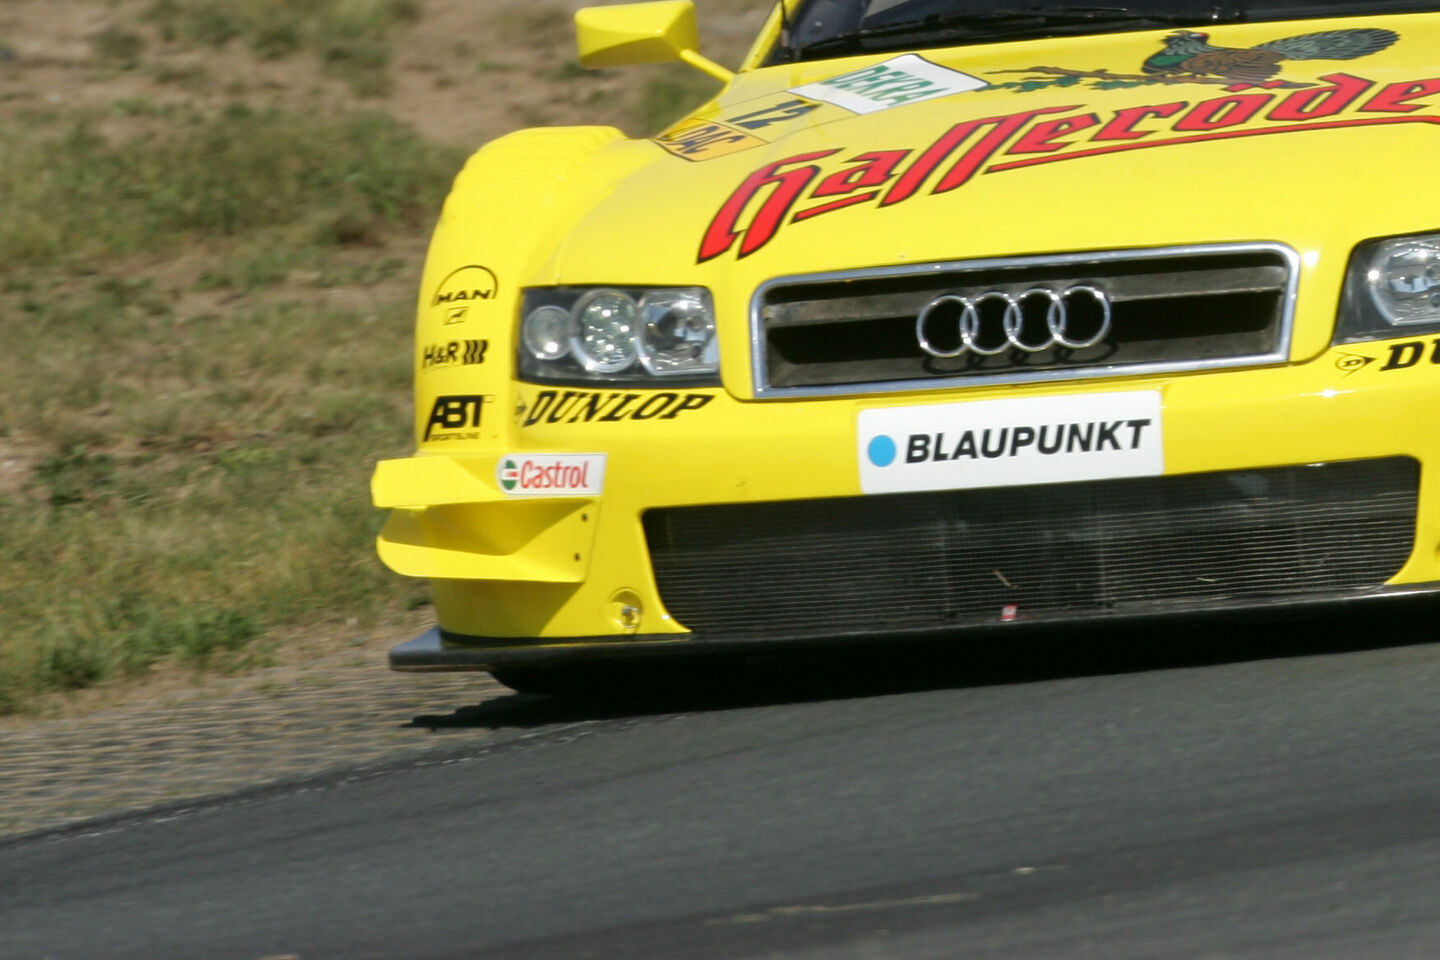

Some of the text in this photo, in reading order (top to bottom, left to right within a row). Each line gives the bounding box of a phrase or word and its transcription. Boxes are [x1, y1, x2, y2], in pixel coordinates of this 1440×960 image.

[817, 65, 949, 107] DEKRA
[437, 289, 491, 305] MAN
[422, 341, 459, 370] H&R
[422, 395, 484, 443] ABT
[523, 390, 716, 428] DUNLOP
[905, 419, 1152, 465] BLAUPUNKT
[520, 460, 589, 490] Castrol
